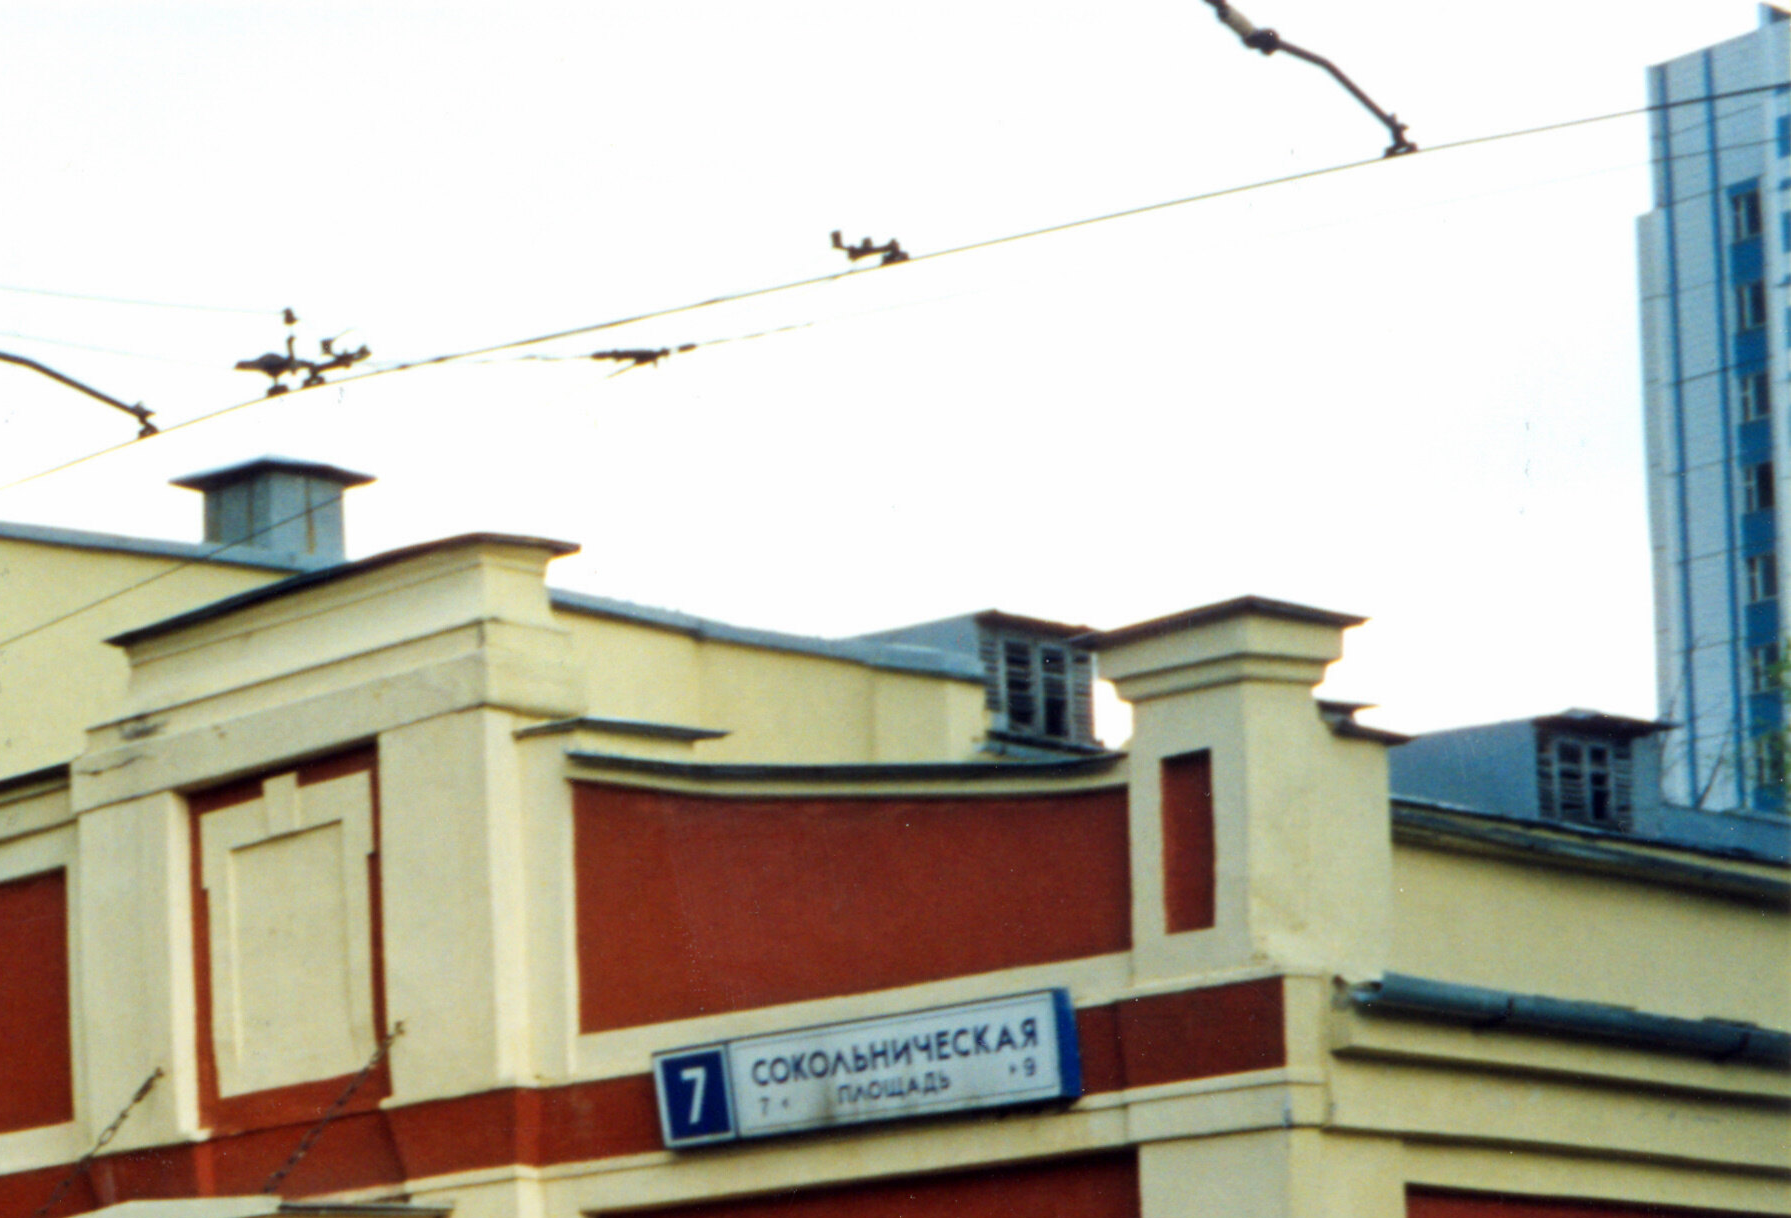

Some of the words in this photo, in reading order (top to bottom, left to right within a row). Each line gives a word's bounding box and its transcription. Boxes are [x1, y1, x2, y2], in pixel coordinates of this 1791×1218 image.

[751, 1016, 1039, 1087] СОКОЛЬНИЧЕСКАЯ
[1023, 1058, 1038, 1079] 9
[679, 1065, 707, 1125] 7
[837, 1071, 951, 1106] ПЛОЩАДЬ
[759, 1096, 771, 1117] 7
